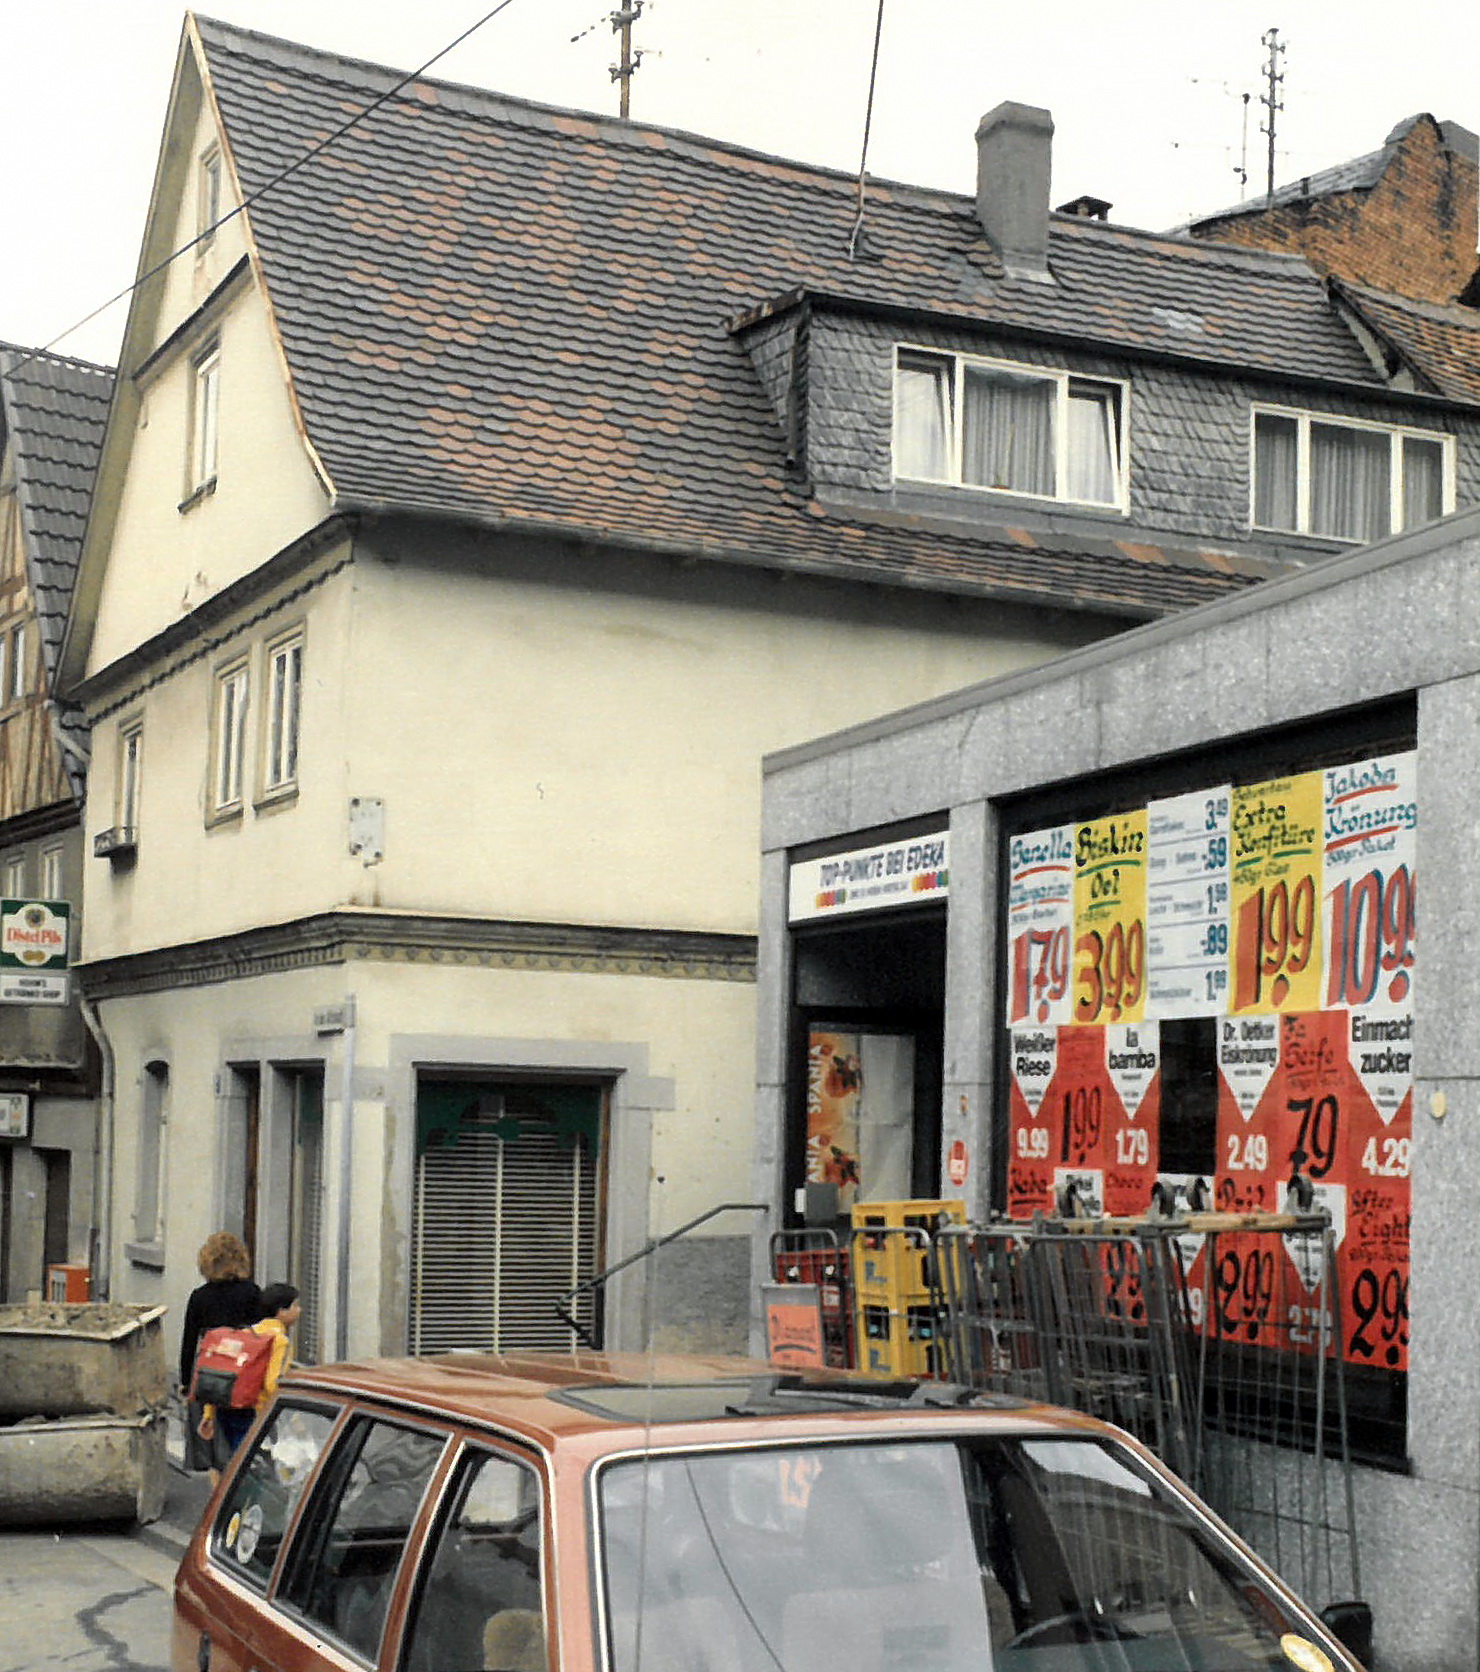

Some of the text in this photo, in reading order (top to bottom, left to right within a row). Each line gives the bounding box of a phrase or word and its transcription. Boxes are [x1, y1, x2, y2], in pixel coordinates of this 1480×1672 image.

[1325, 803, 1417, 839] Krönung
[886, 849, 904, 876] BEI
[906, 841, 945, 872] EDEKA
[1016, 1057, 1051, 1076] Riese
[1109, 1047, 1156, 1069] bamba
[1360, 1047, 1411, 1073] zucker
[1017, 1128, 1049, 1158] 9.99
[1115, 1129, 1149, 1165] 1.79
[1227, 1134, 1269, 1171] 2.49
[1361, 1137, 1411, 1178] 4.29
